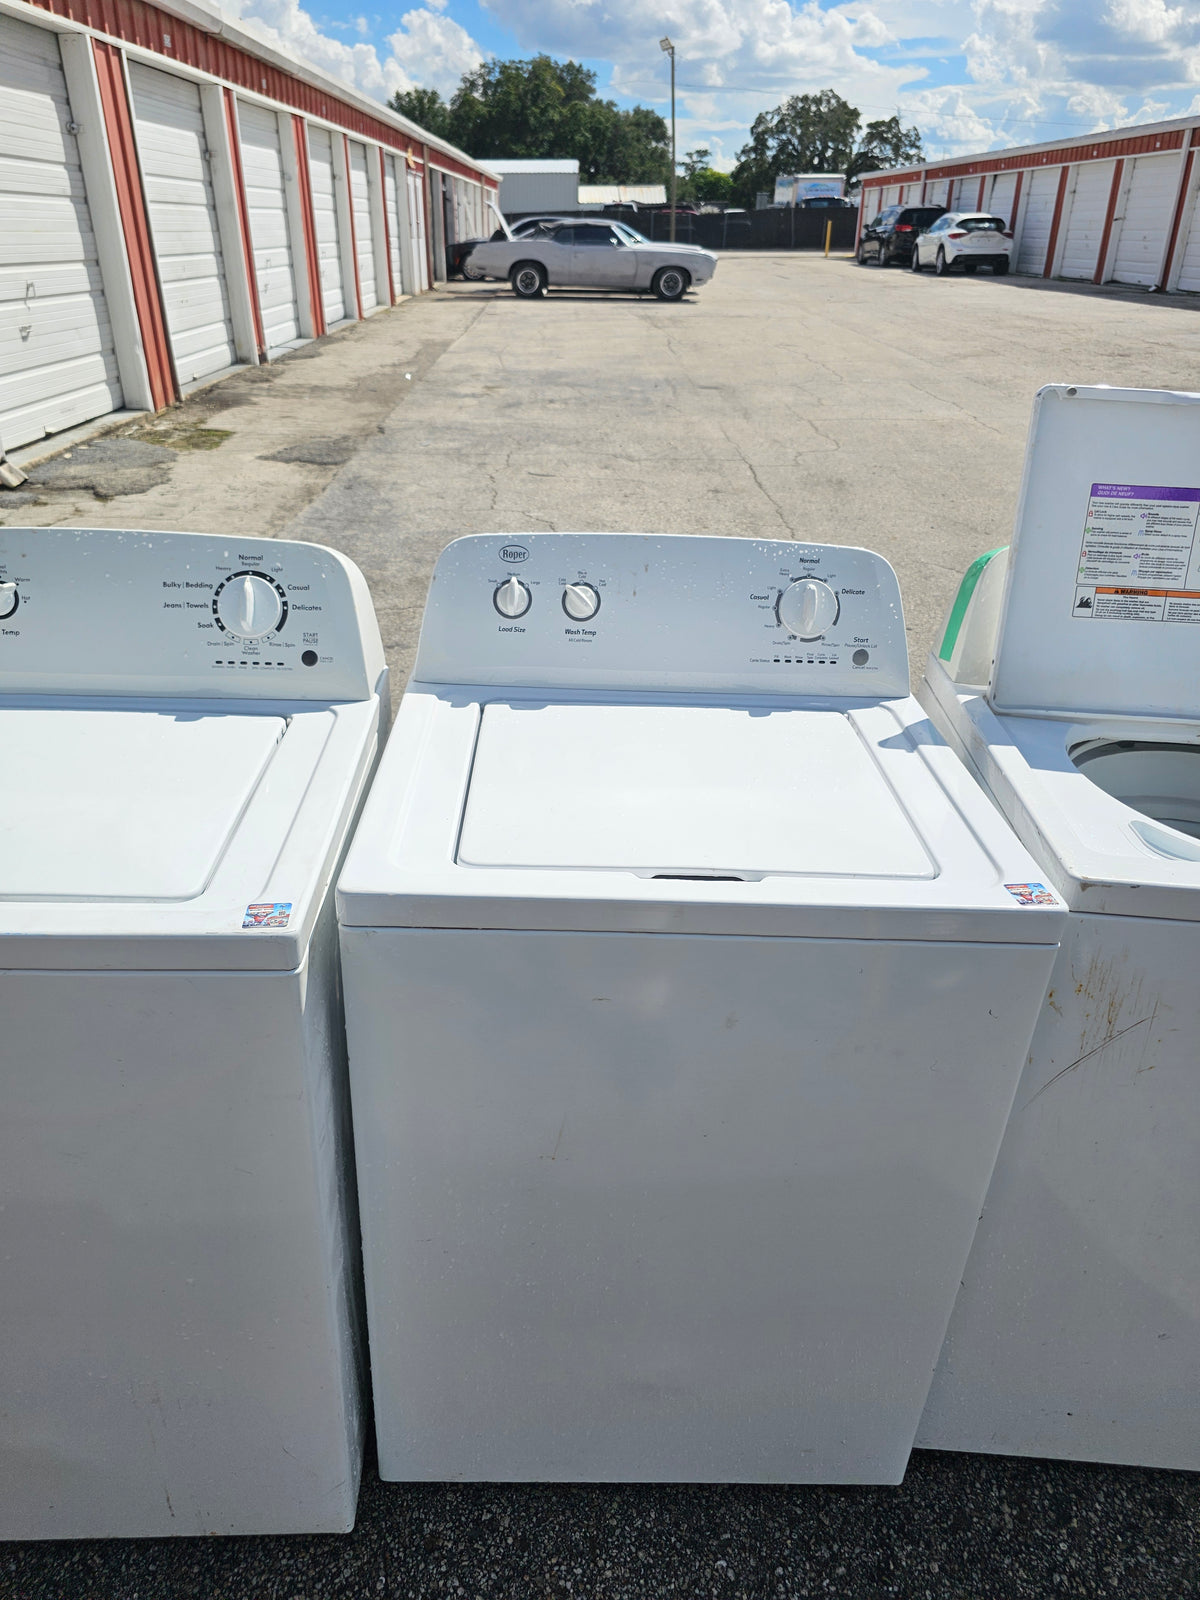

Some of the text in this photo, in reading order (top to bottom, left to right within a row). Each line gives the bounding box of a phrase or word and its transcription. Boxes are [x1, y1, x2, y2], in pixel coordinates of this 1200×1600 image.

[502, 549, 527, 560] Roper
[185, 581, 213, 590] Bedding
[841, 588, 866, 596] Delicate
[2, 629, 20, 637] Temp
[581, 629, 597, 637] Temp
